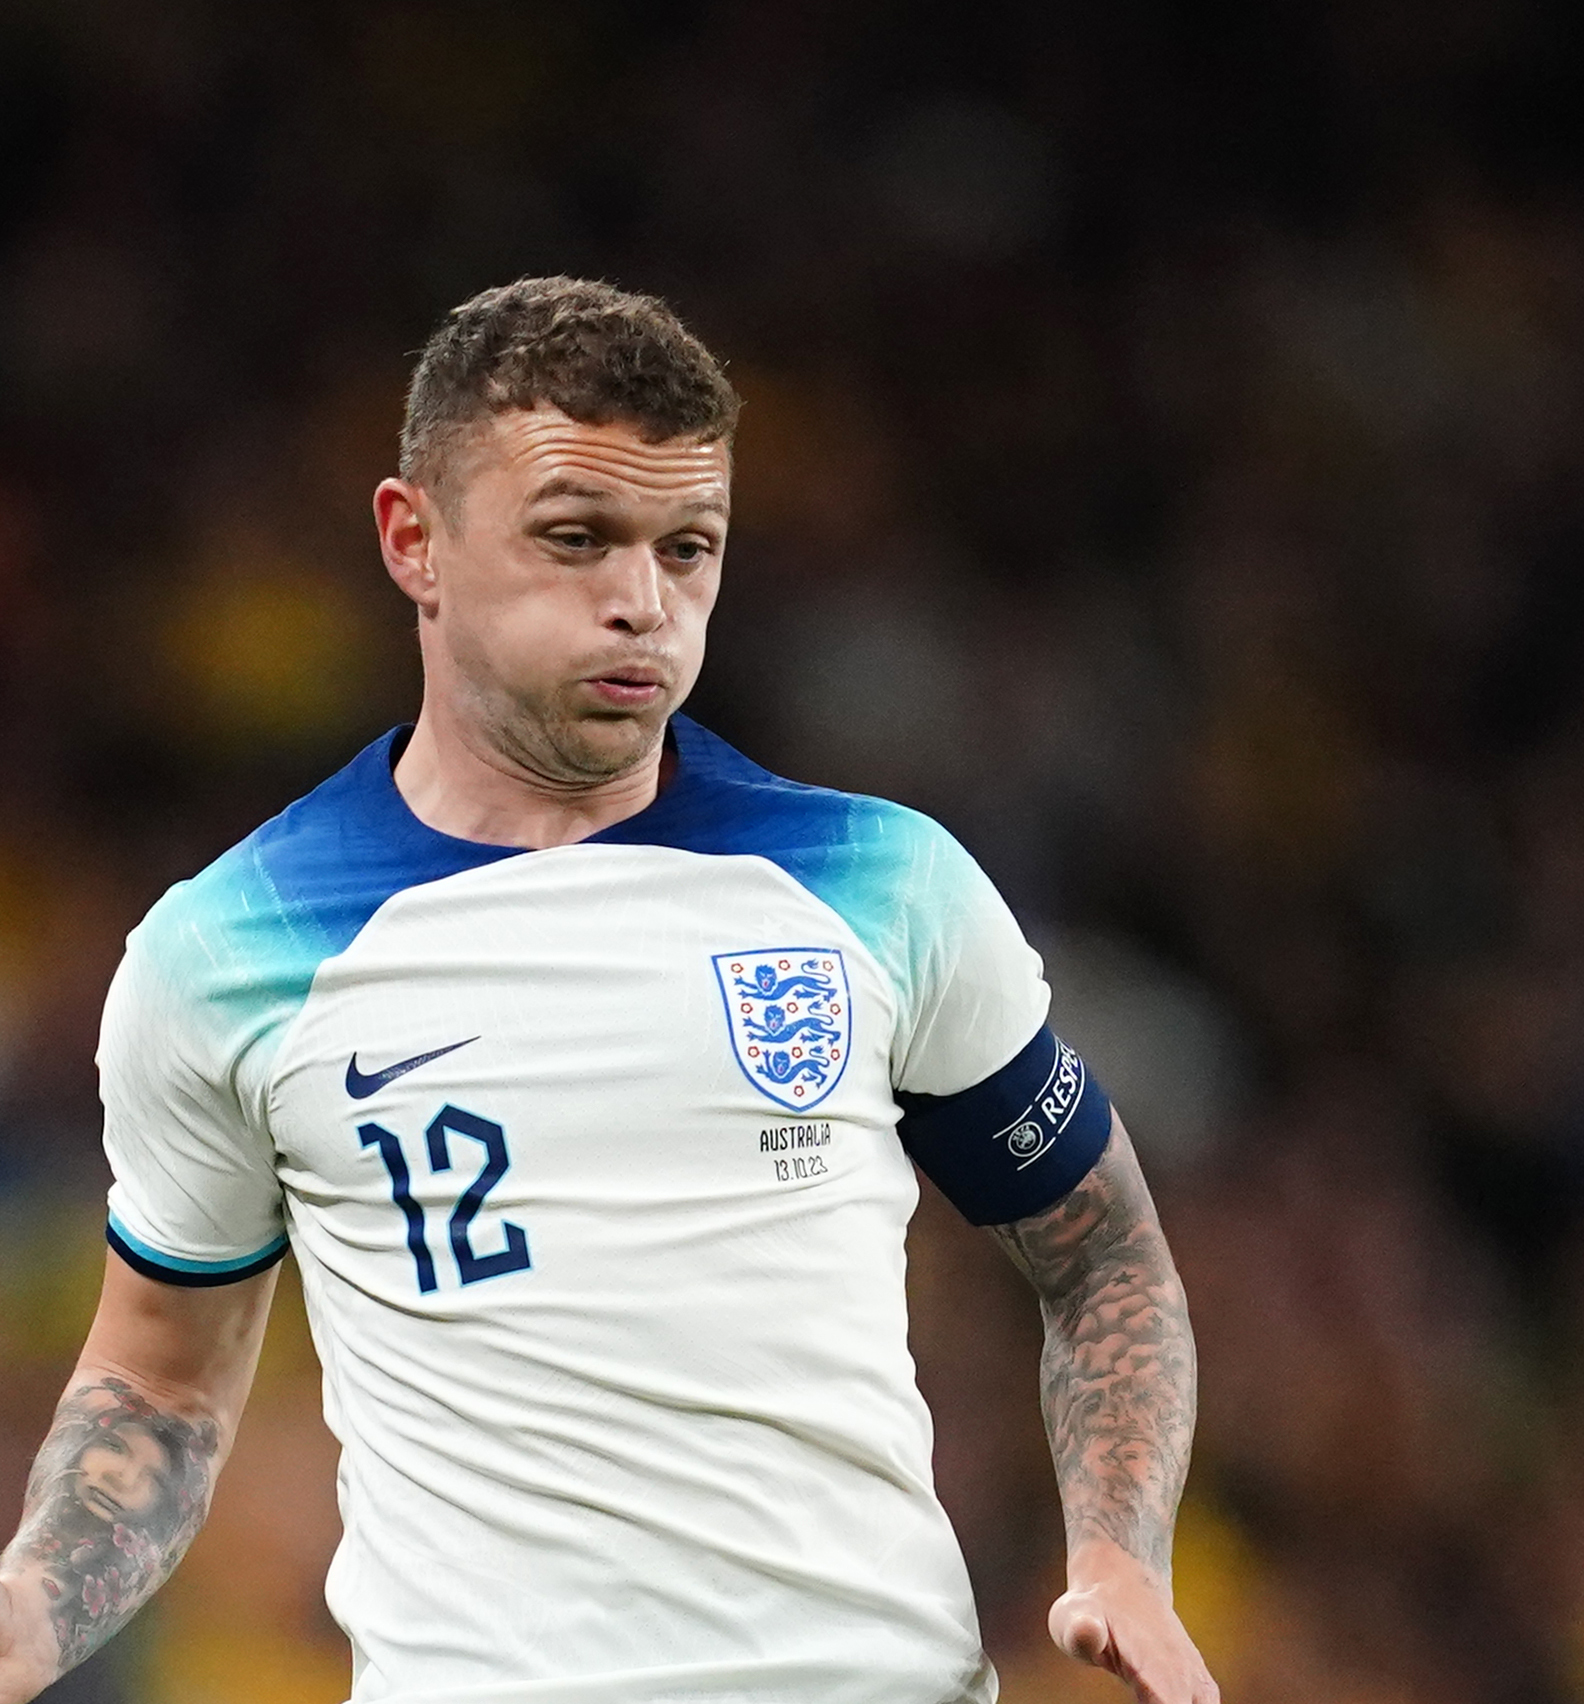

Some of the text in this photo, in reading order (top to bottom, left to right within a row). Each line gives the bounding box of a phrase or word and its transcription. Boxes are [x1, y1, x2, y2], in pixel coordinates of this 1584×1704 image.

[759, 1122, 831, 1153] AUSTRALIA
[773, 1155, 828, 1182] 13.10.23
[356, 1102, 532, 1296] 12
